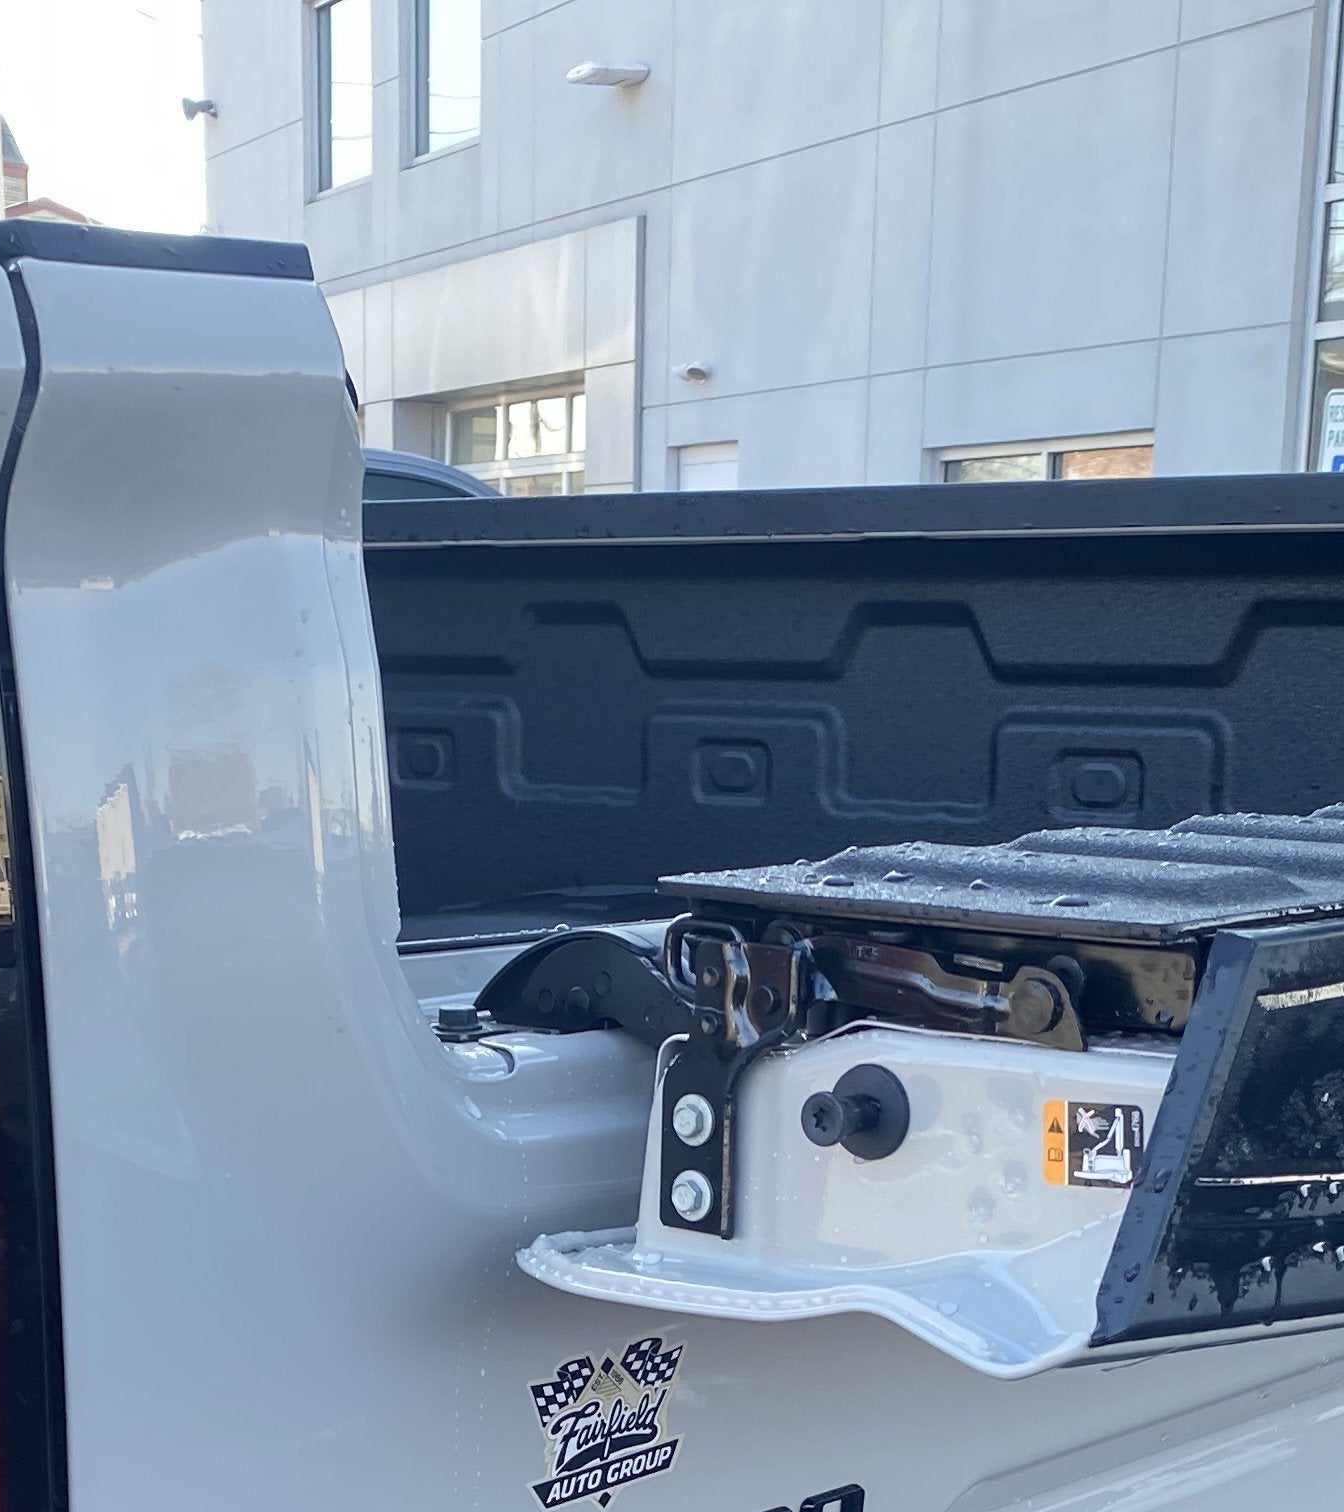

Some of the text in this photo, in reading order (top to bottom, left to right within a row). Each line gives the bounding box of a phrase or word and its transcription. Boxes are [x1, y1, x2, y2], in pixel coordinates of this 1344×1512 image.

[549, 1388, 668, 1475] Fairfield
[545, 1446, 672, 1504] AUTO GROUP
